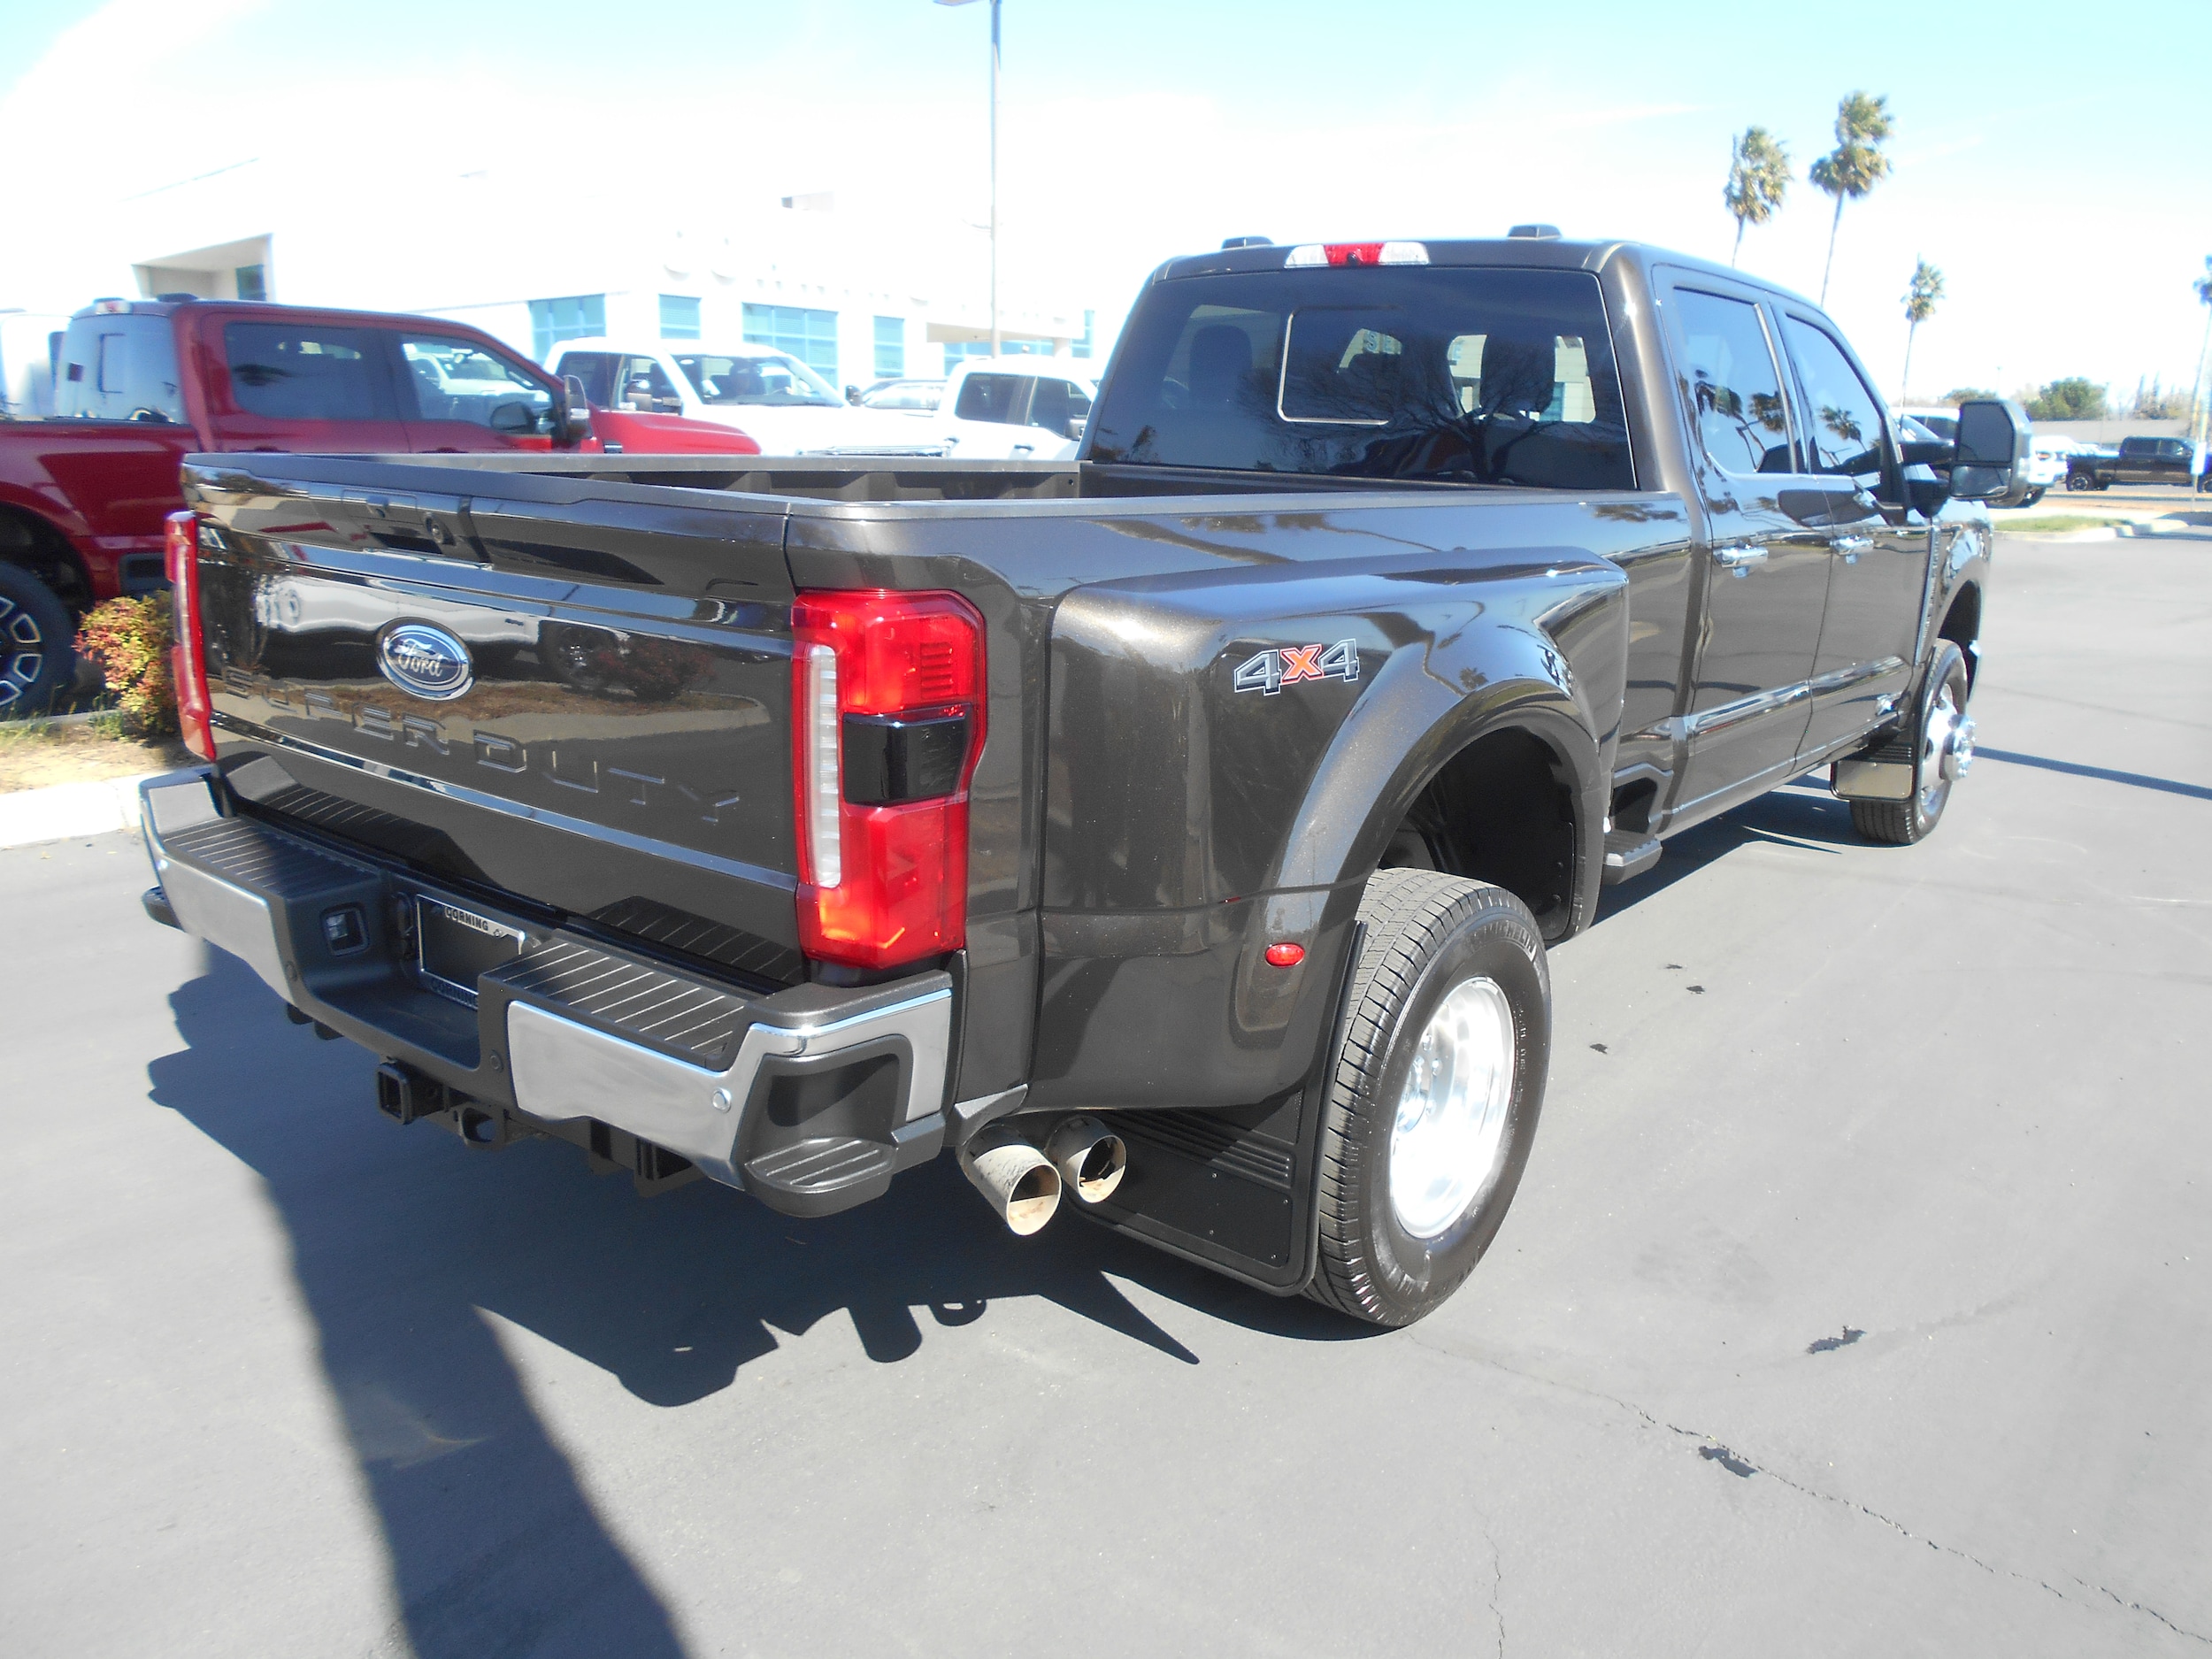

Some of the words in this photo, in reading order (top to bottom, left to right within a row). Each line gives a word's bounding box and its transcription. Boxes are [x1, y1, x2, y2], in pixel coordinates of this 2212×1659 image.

[394, 638, 442, 677] Ford
[223, 665, 449, 755] SUPER
[472, 729, 741, 824] DUTY
[444, 906, 488, 931] CORNING
